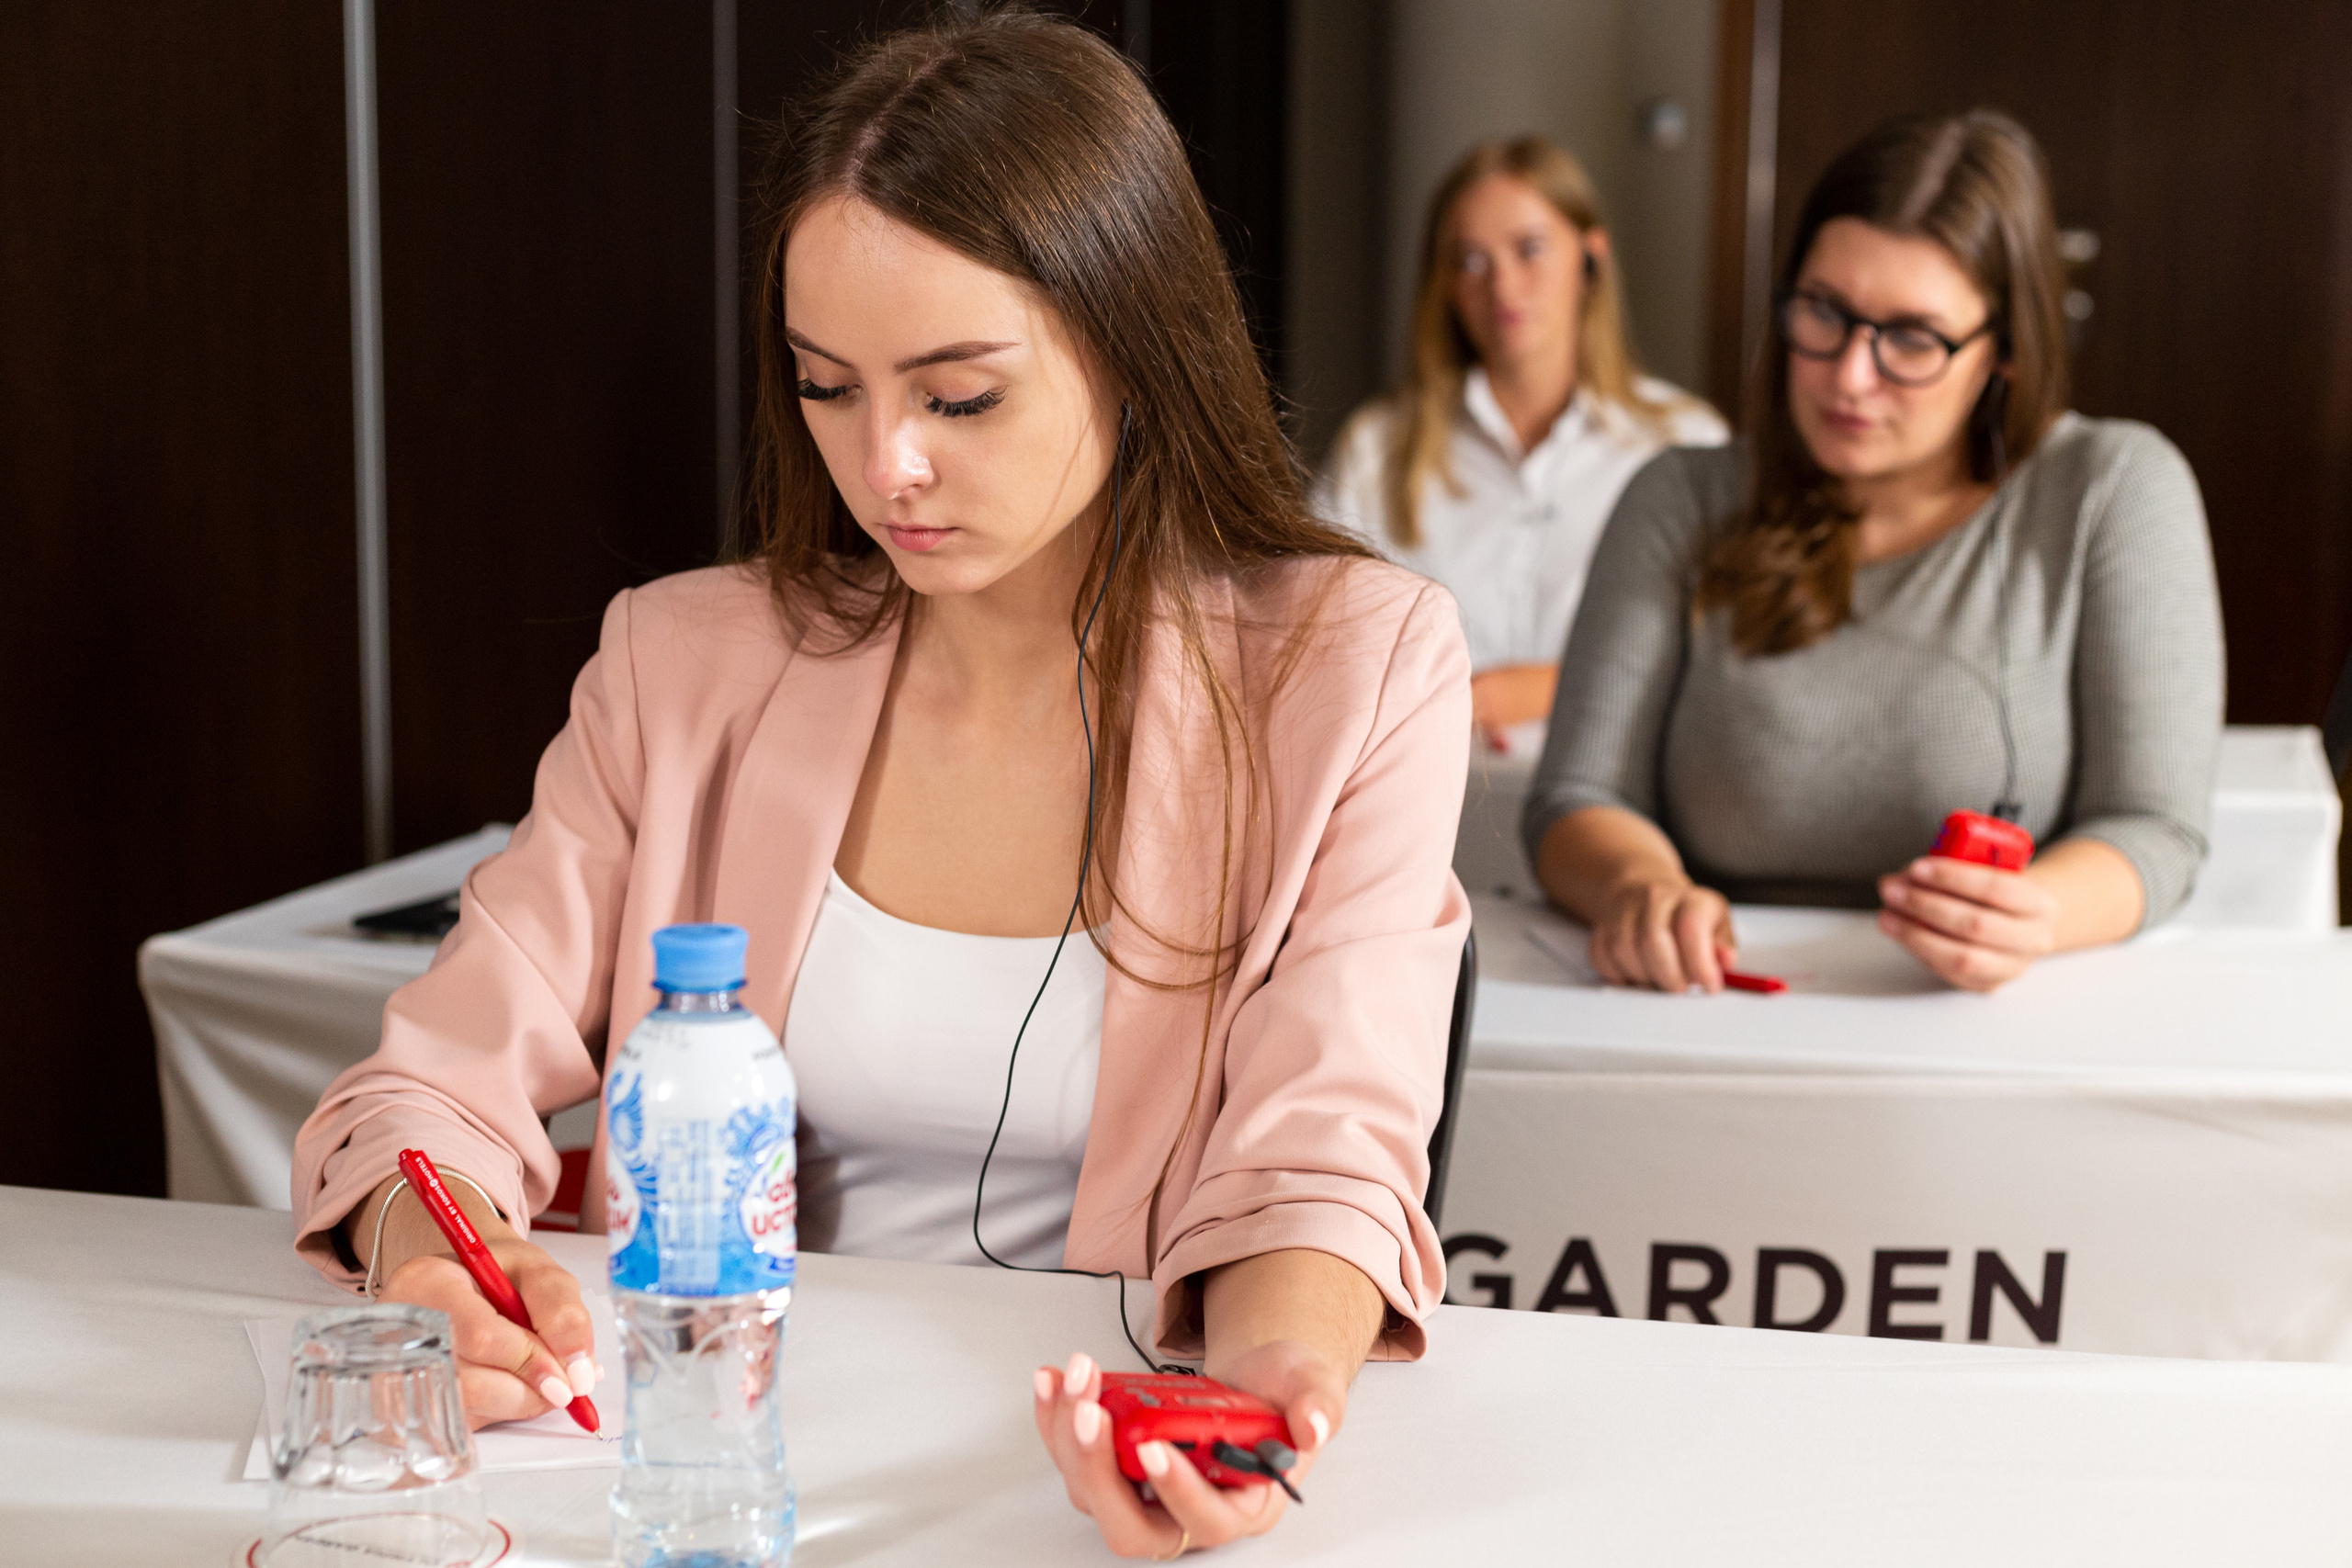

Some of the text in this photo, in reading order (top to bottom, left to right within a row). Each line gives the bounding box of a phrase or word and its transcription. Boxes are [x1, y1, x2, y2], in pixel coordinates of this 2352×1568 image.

[415, 1156, 476, 1244] ORIGINAL BY SOKOS HOTELS
[1442, 1232, 2067, 1344] GARDEN
